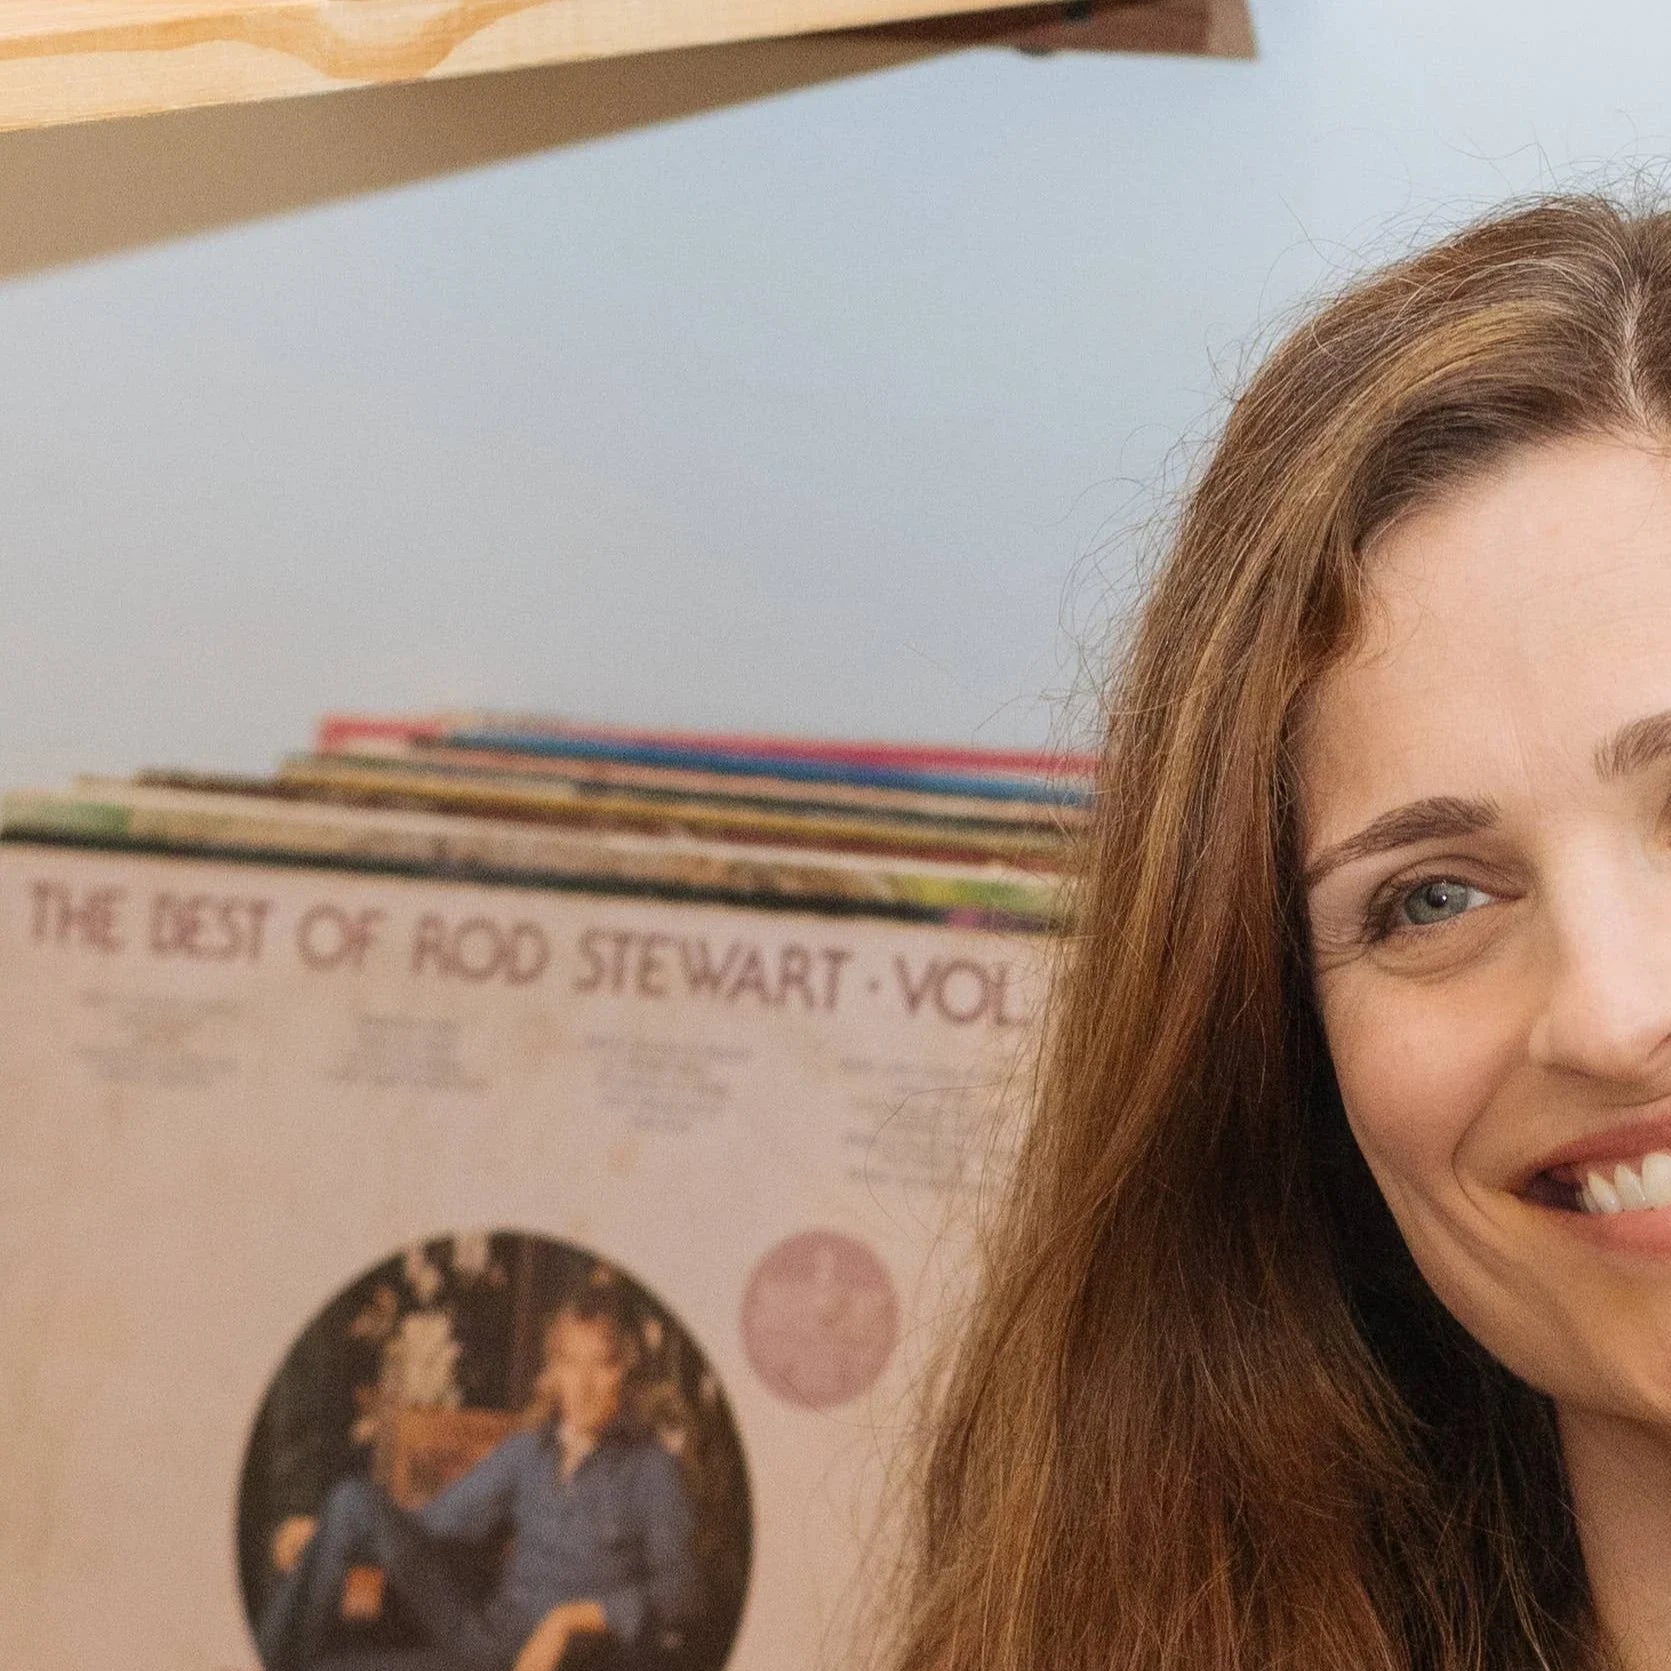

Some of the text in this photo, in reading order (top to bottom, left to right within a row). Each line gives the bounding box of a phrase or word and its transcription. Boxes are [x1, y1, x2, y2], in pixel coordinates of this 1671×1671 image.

[28, 880, 127, 956] THE
[150, 893, 272, 961] BEST
[297, 903, 386, 973] OF
[410, 913, 551, 986] ROD
[573, 927, 853, 1012] STEWART
